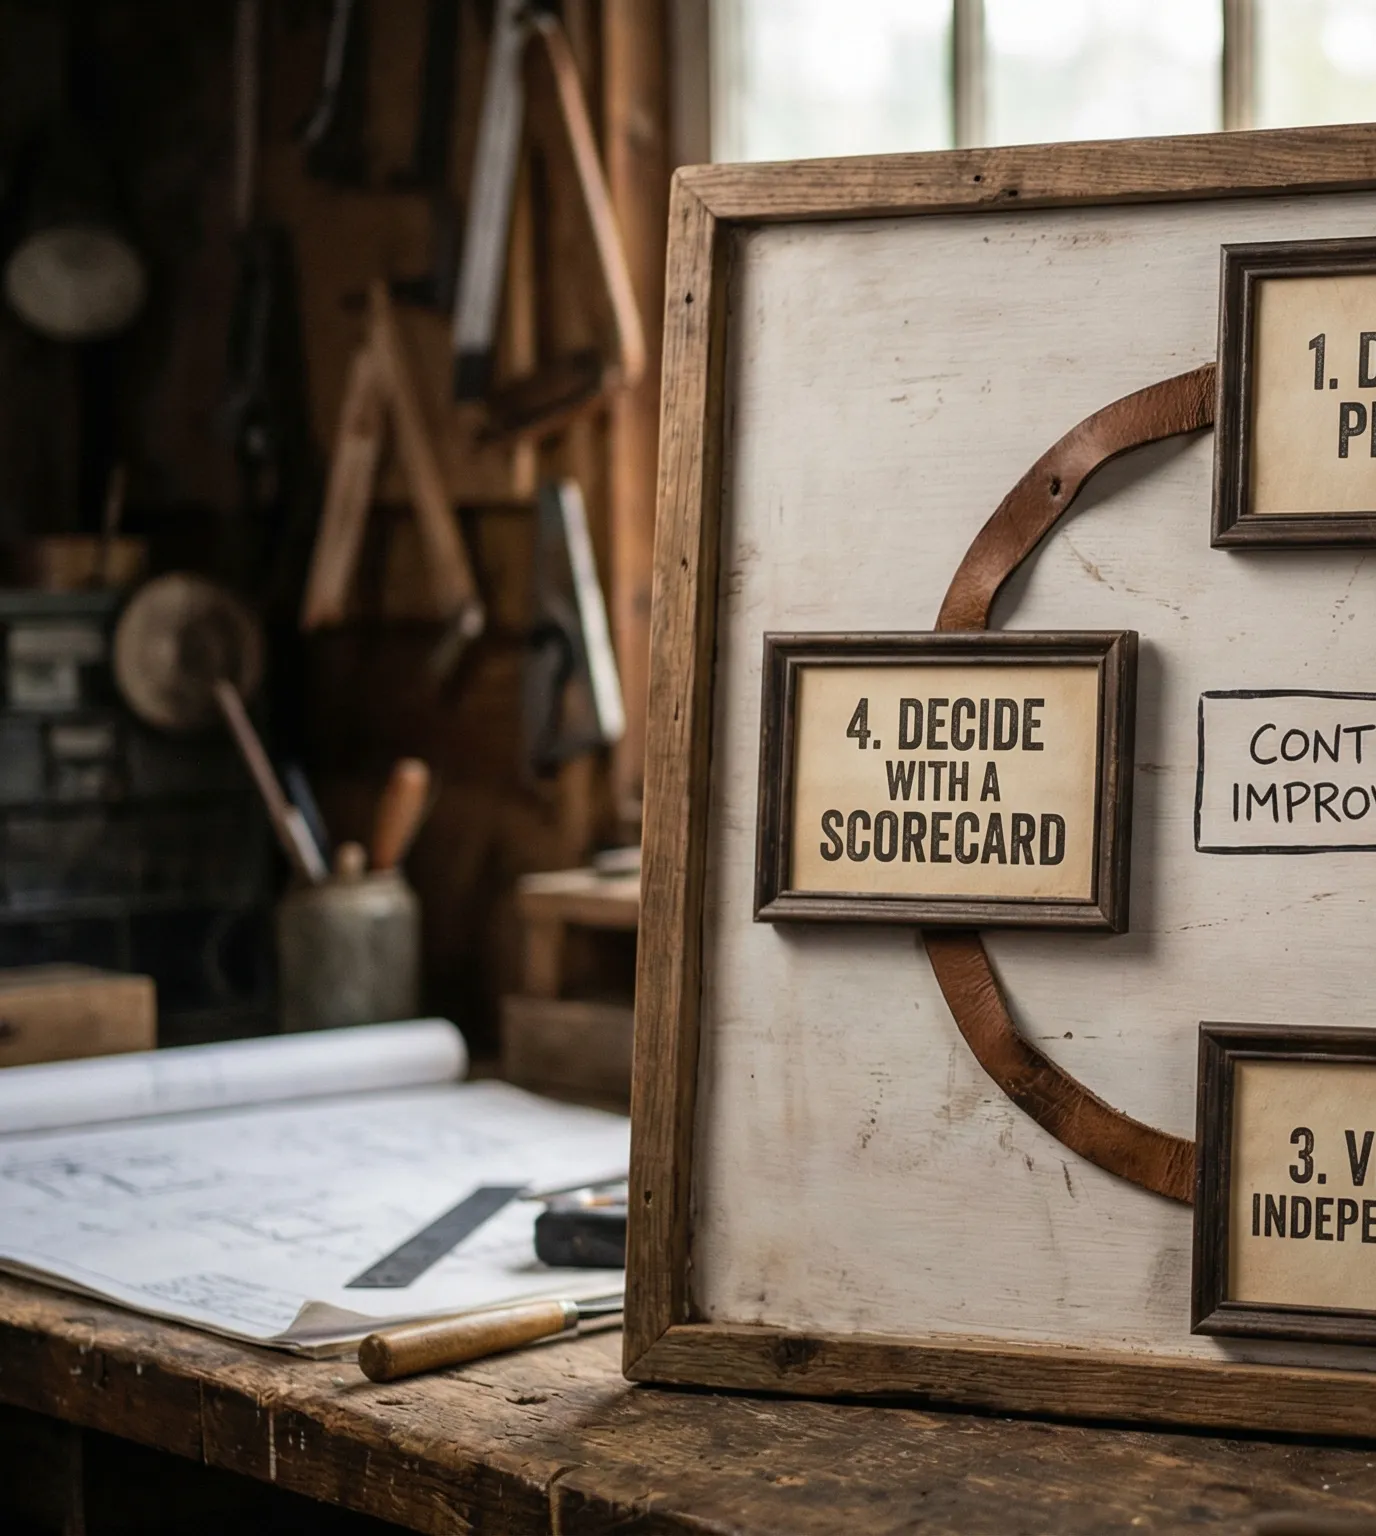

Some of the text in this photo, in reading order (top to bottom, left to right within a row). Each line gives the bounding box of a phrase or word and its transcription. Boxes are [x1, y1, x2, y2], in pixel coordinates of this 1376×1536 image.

[1309, 333, 1338, 389] 1.
[846, 697, 1045, 751] 4. DECIDE
[885, 760, 1001, 802] WITH A
[819, 809, 1066, 866] SCORECARD
[1289, 1127, 1327, 1185] 3.
